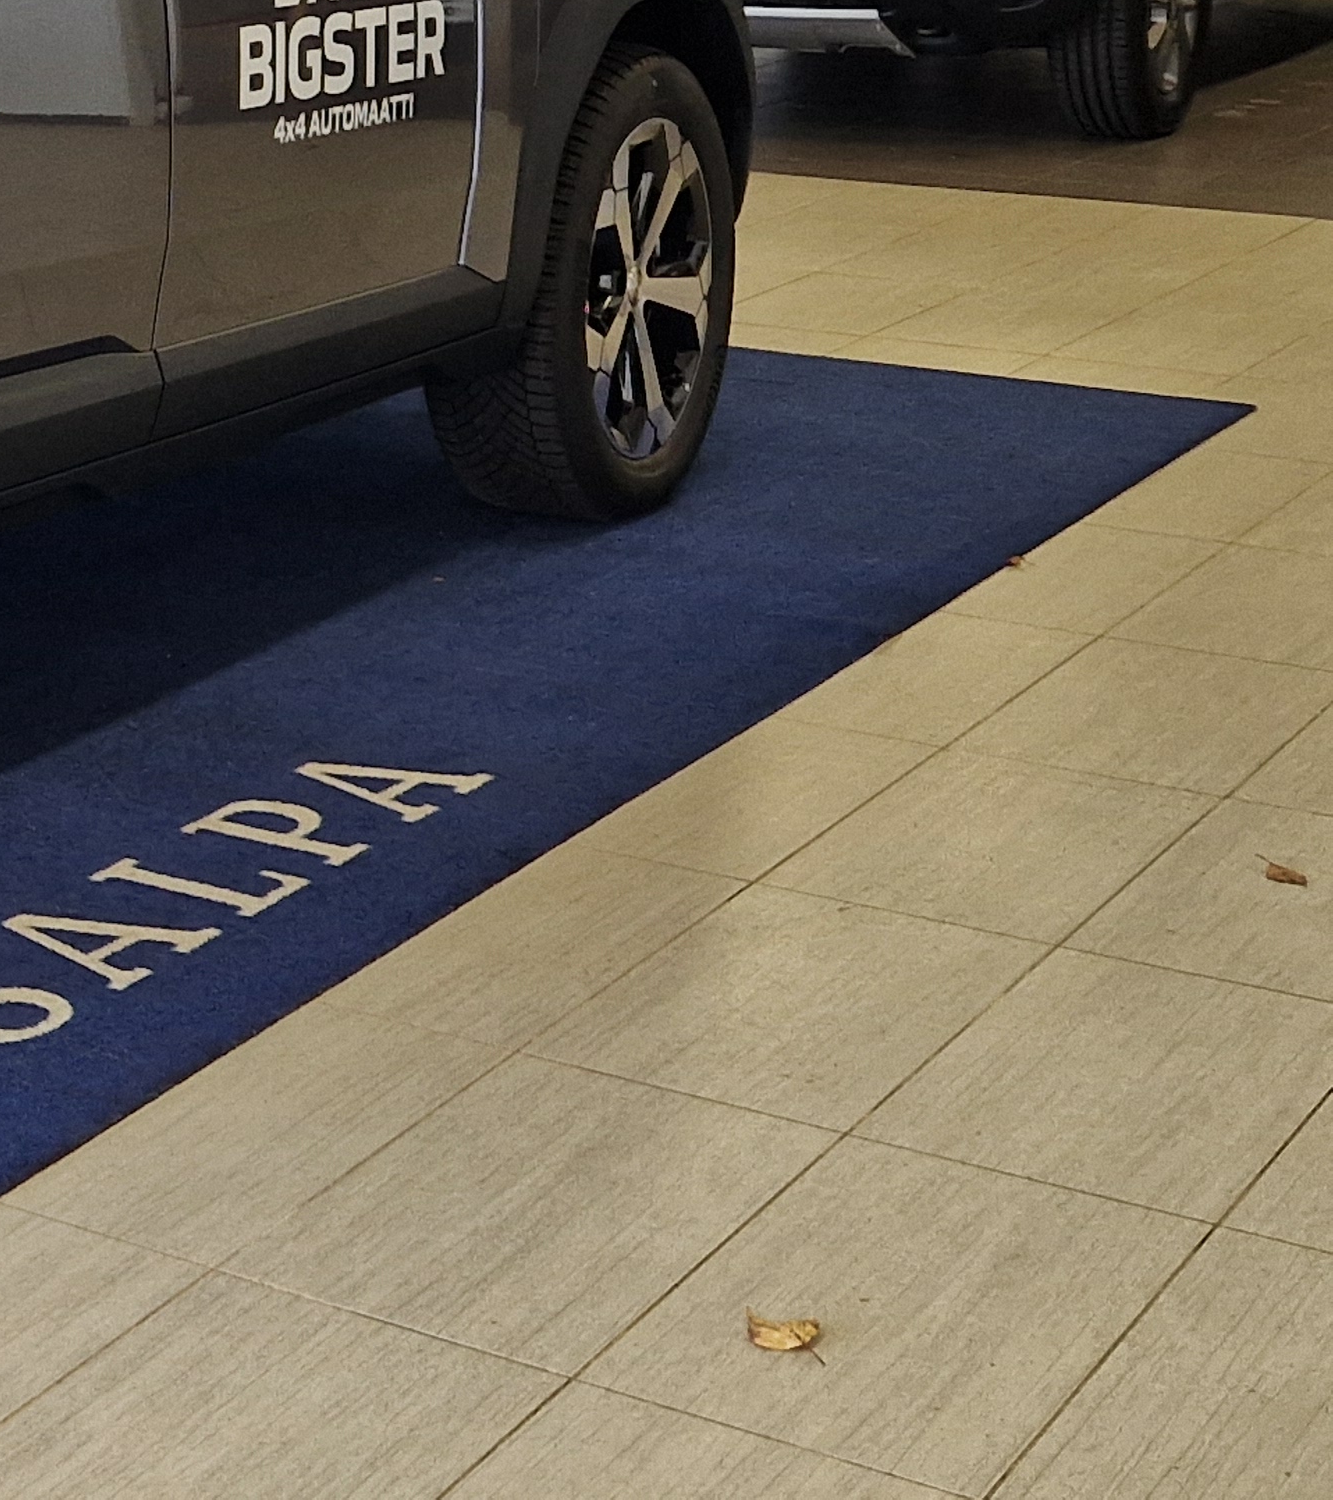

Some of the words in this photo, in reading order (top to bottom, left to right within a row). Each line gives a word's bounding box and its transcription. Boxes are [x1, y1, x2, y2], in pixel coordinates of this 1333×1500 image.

[239, 0, 445, 111] BIGSTER
[274, 112, 306, 143] 4x4
[308, 92, 415, 138] AUTOMAATTI
